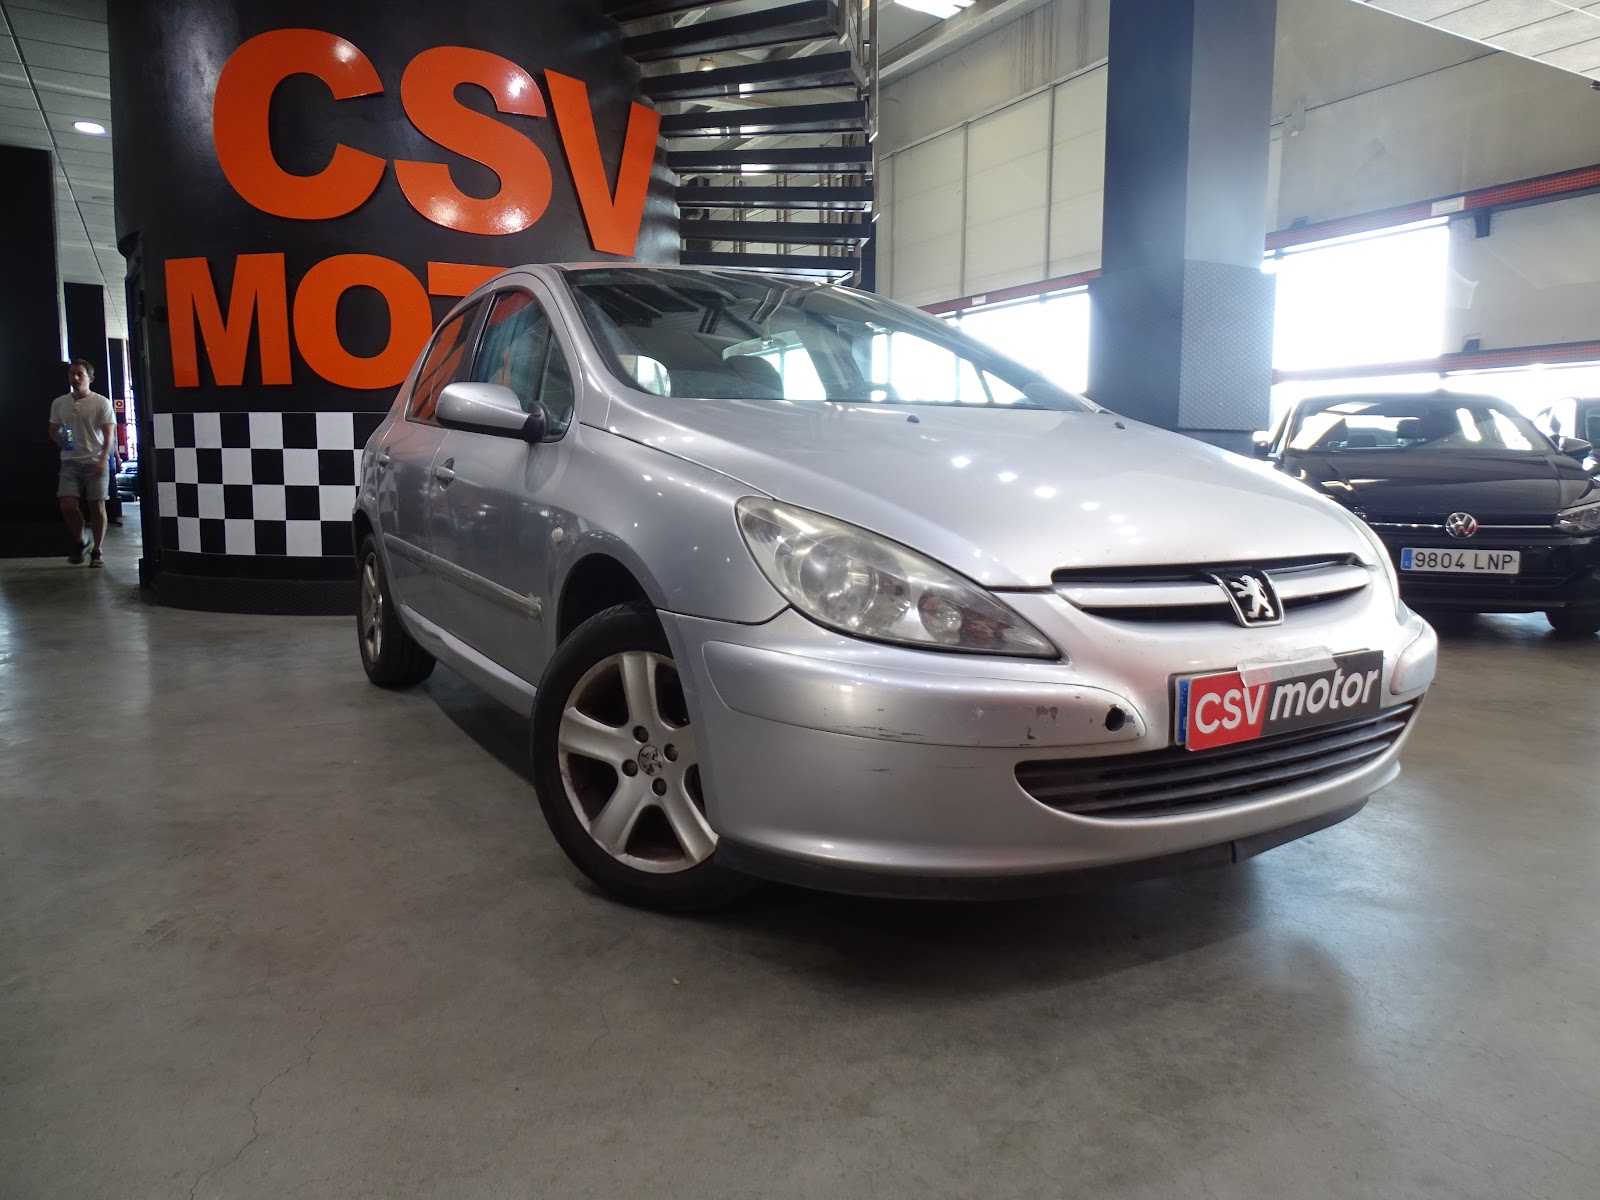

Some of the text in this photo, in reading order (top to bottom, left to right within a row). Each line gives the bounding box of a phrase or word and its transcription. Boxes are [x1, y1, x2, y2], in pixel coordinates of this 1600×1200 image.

[213, 28, 661, 257] CSV
[1414, 551, 1513, 571] 9804 LNP
[1195, 667, 1380, 734] CSV motor
